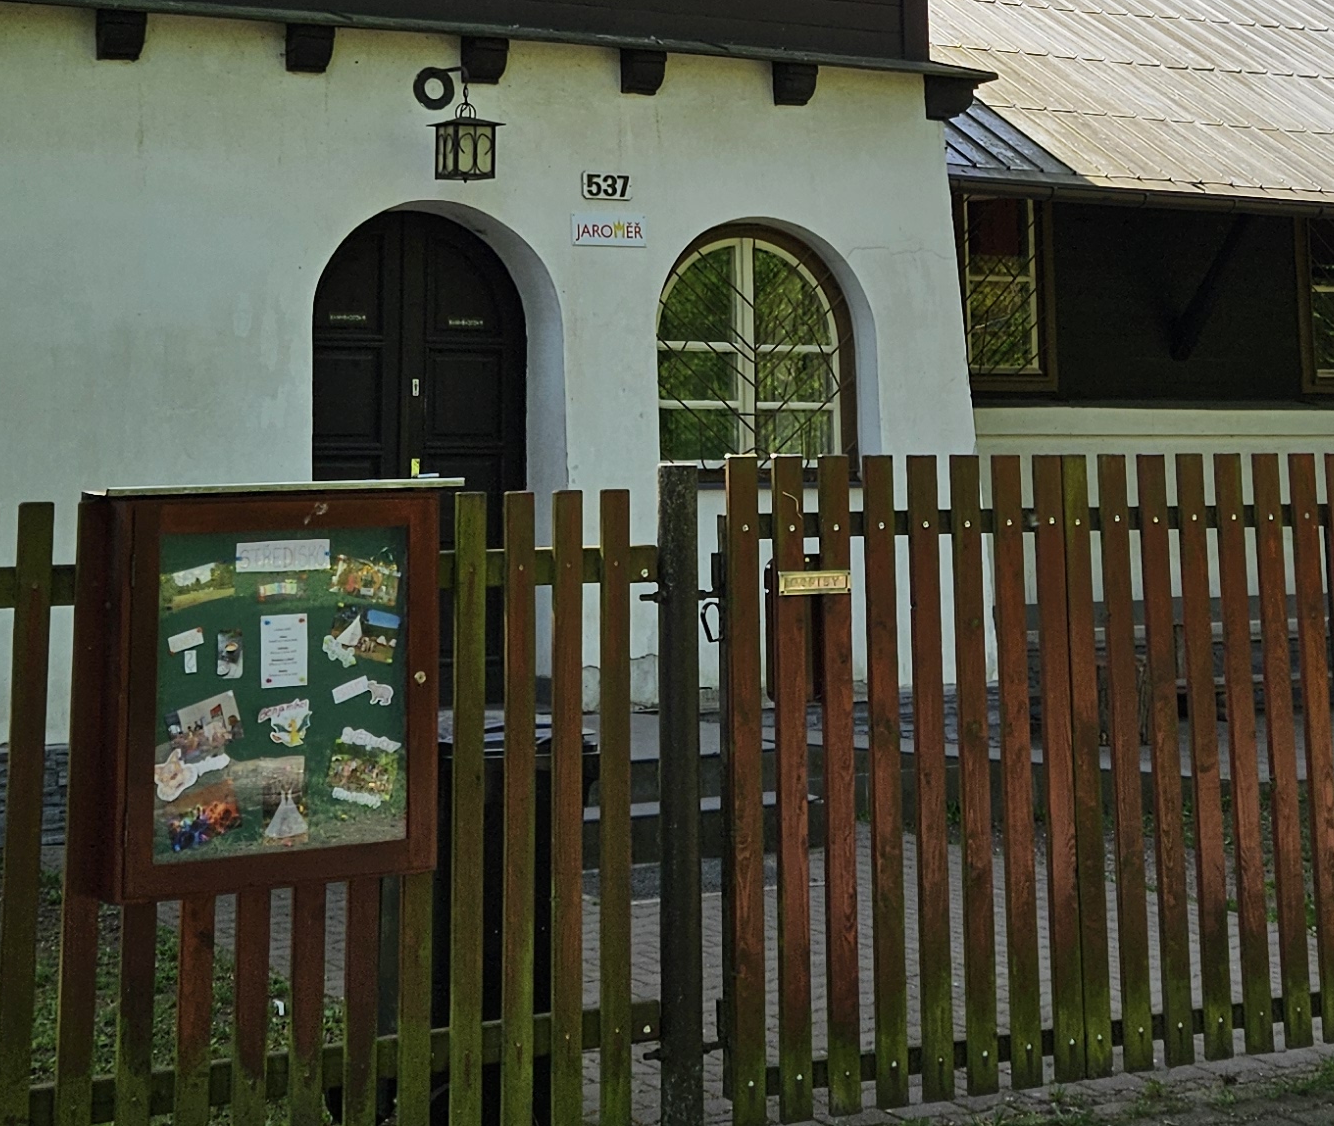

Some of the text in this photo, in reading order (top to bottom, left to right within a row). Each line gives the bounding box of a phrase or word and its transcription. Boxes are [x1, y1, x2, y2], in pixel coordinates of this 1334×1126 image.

[586, 173, 629, 198] 537
[575, 220, 643, 241] JAROMĚŘ
[239, 543, 326, 569] STŘEDISKO
